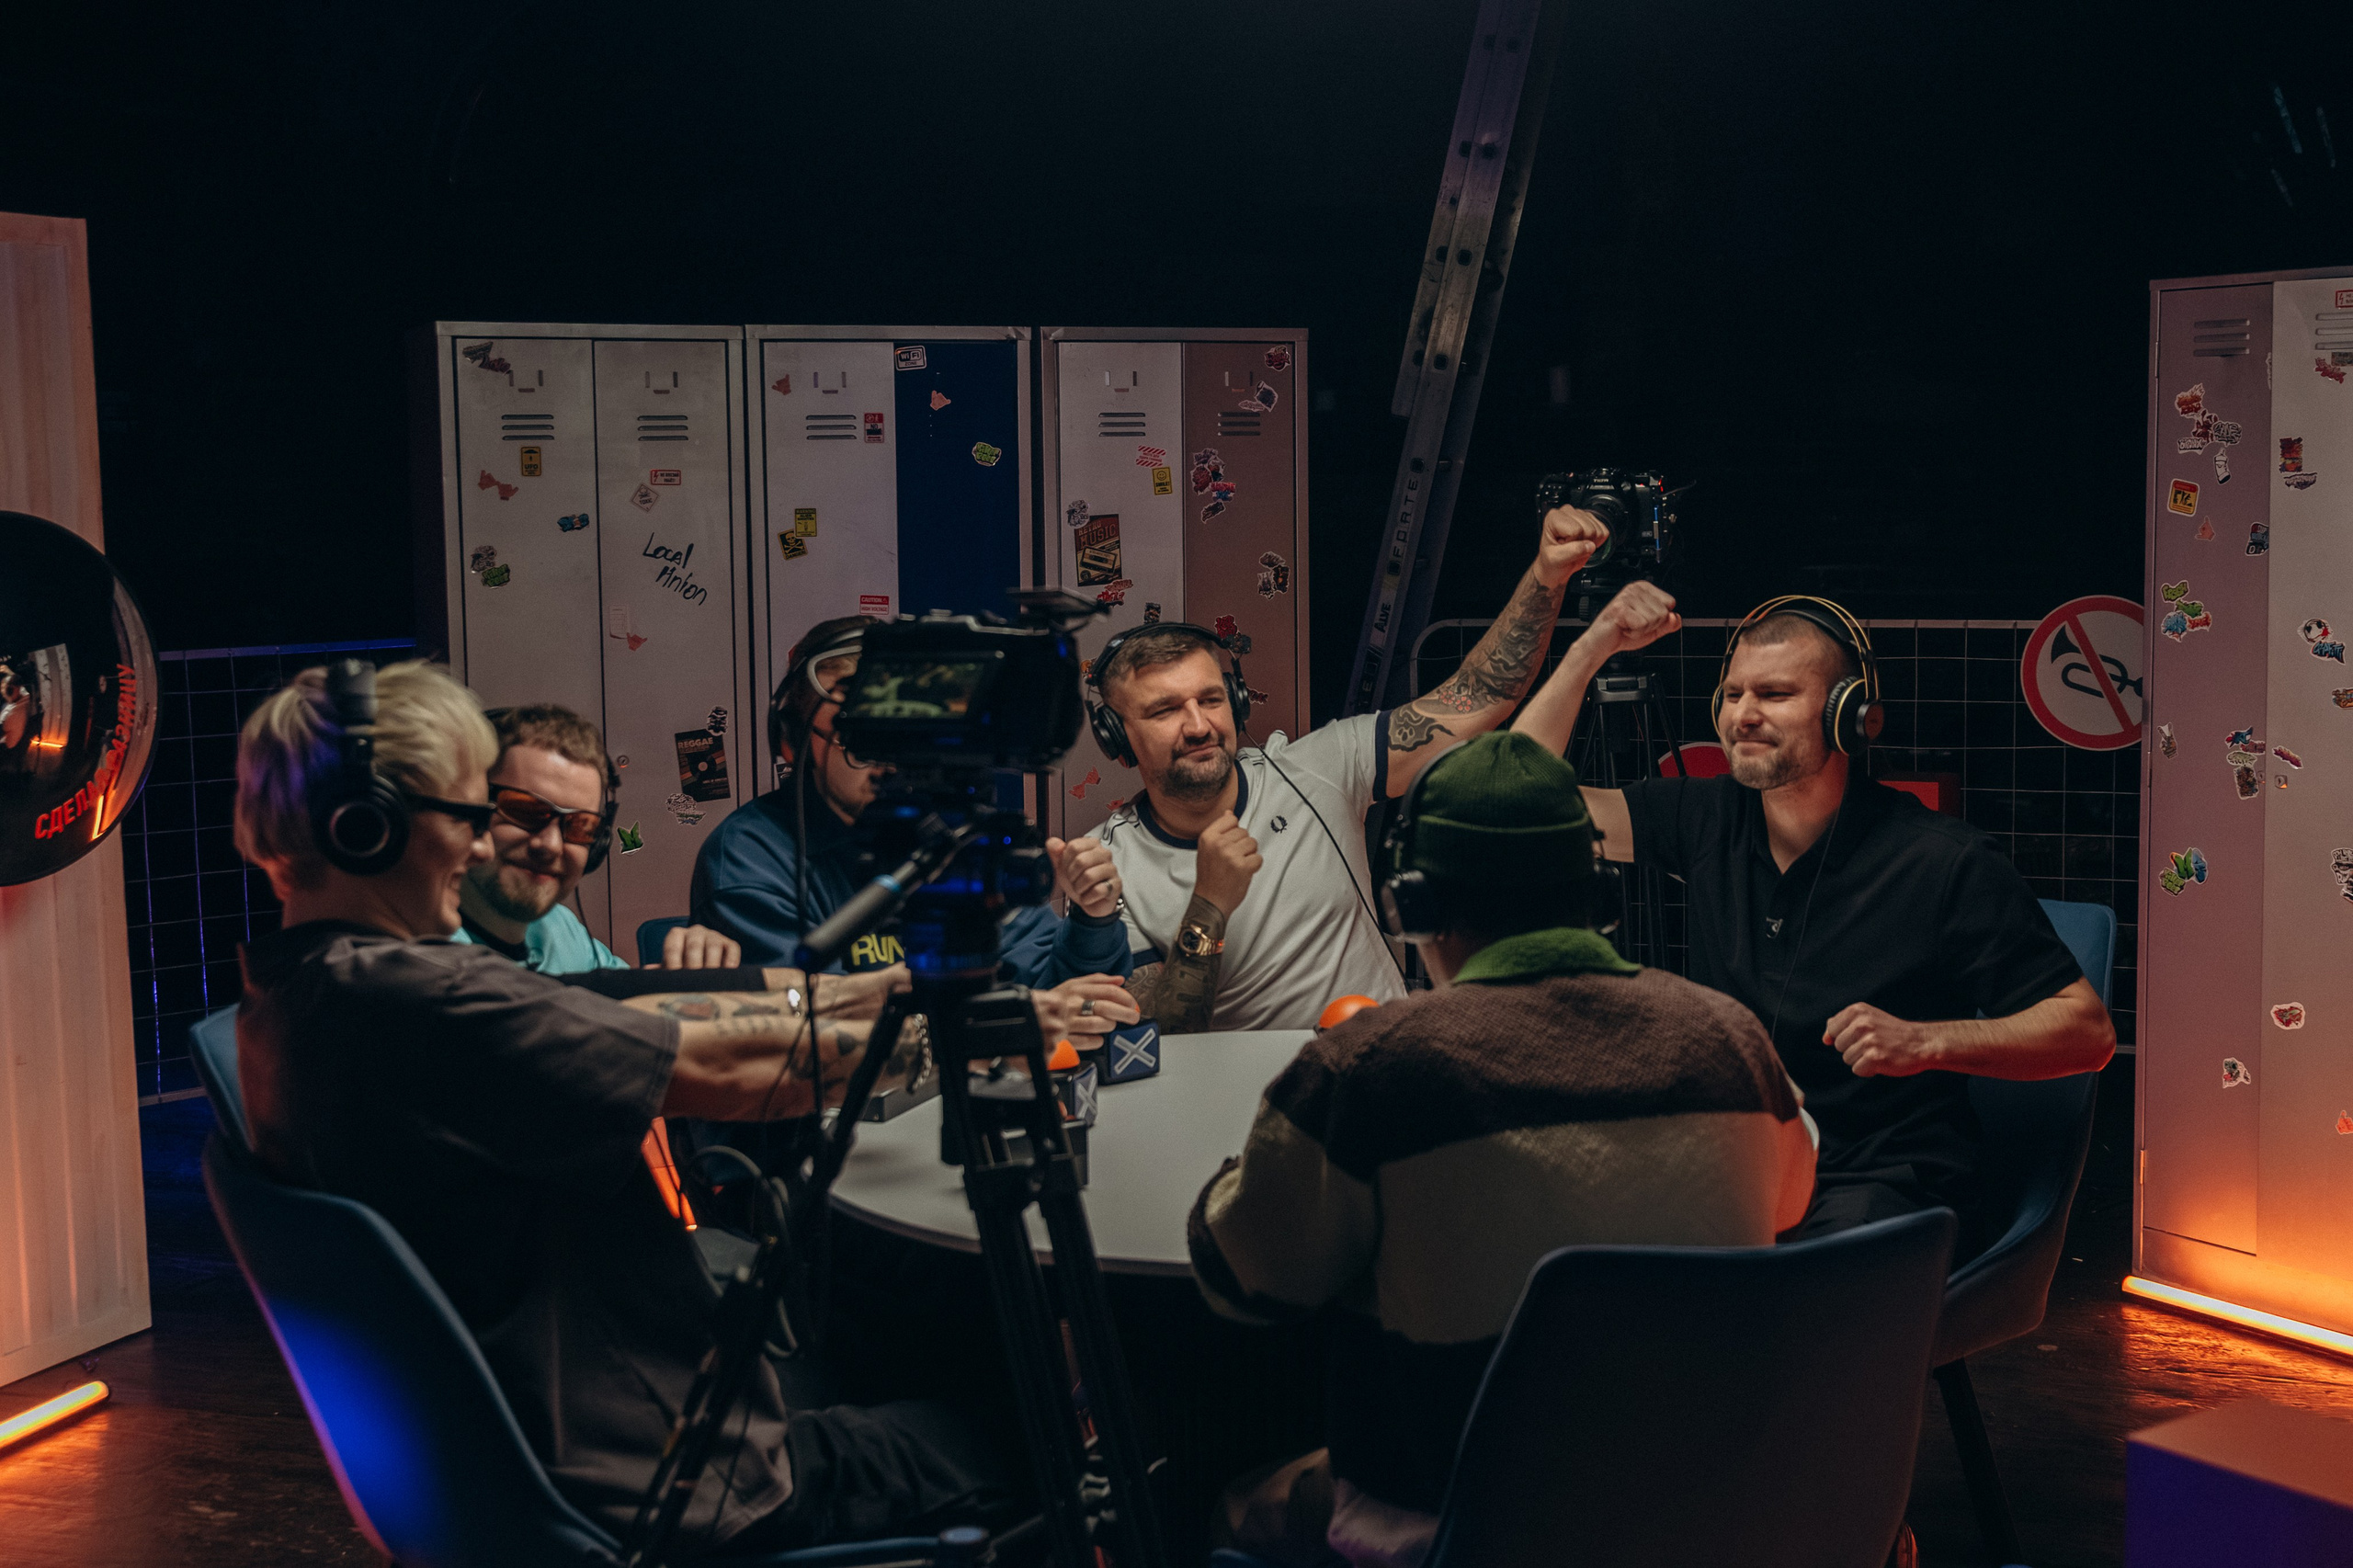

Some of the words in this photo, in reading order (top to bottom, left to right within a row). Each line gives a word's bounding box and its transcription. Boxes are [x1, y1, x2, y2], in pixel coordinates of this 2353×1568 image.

[1078, 520, 1102, 536] RETRO
[1392, 479, 1418, 558] FORTE
[642, 532, 694, 569] Local
[1079, 523, 1117, 551] MUSIC
[677, 736, 714, 749] REGGAE
